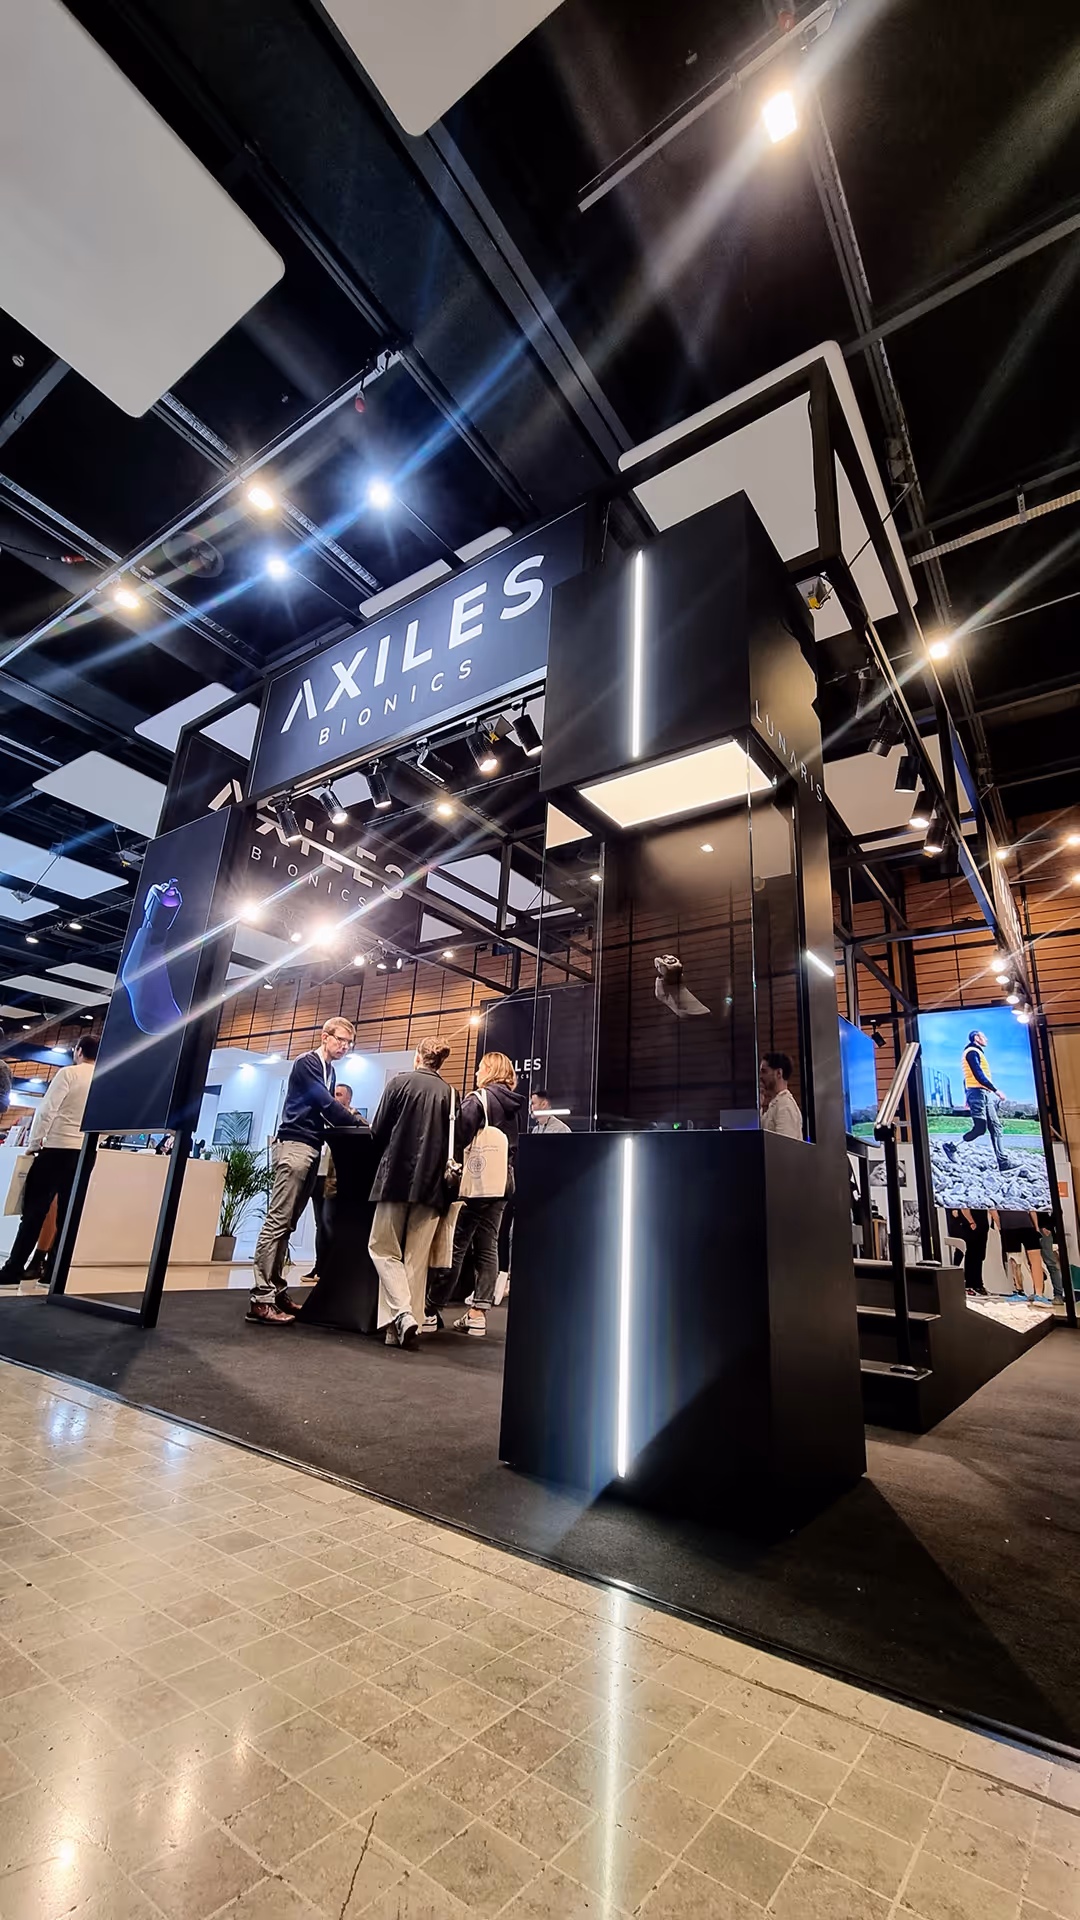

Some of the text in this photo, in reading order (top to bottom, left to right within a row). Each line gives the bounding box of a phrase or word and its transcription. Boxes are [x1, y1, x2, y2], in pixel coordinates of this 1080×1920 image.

[281, 555, 545, 734] AXILES
[318, 659, 473, 746] BIONICS
[755, 699, 823, 802] LUNARIS
[250, 845, 367, 910] BIONICS
[510, 1057, 542, 1072] LES
